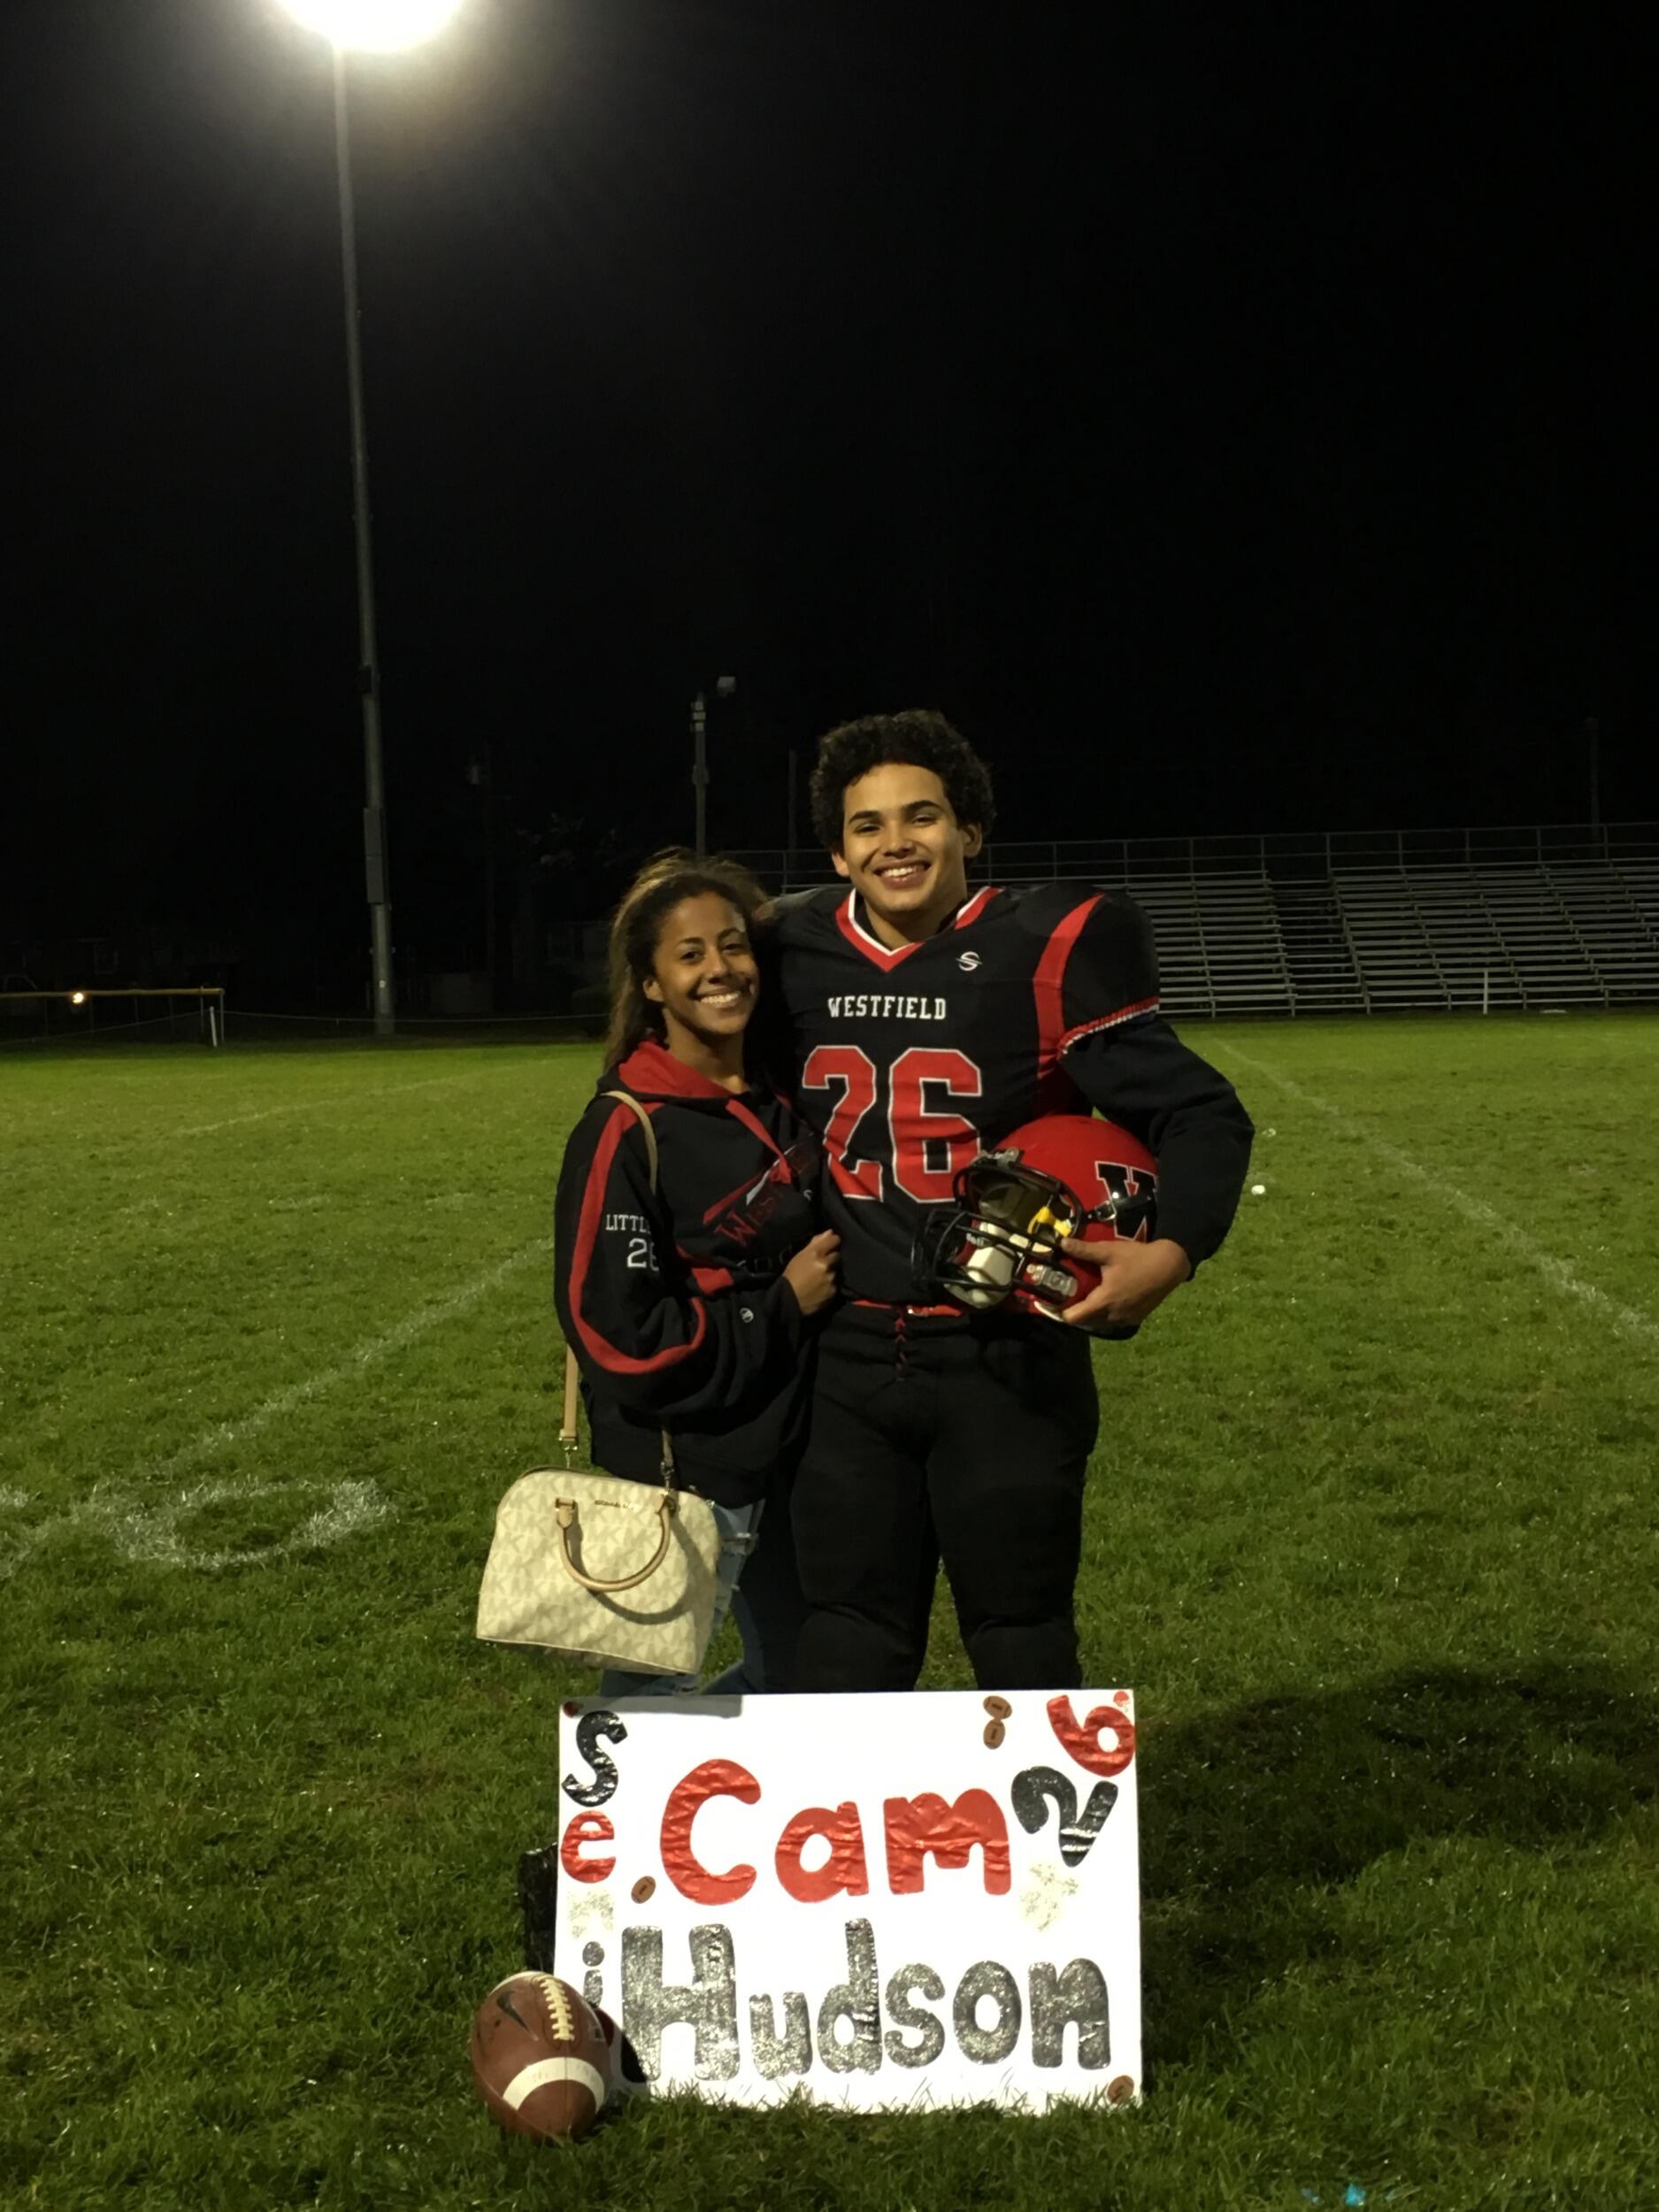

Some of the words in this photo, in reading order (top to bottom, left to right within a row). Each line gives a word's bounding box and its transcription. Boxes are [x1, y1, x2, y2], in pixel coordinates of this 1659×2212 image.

[827, 995, 947, 1020] WESTFIELD
[803, 1045, 981, 1203] 26
[660, 1758, 1011, 1906] Cam
[621, 1917, 1111, 2081] Hudson
